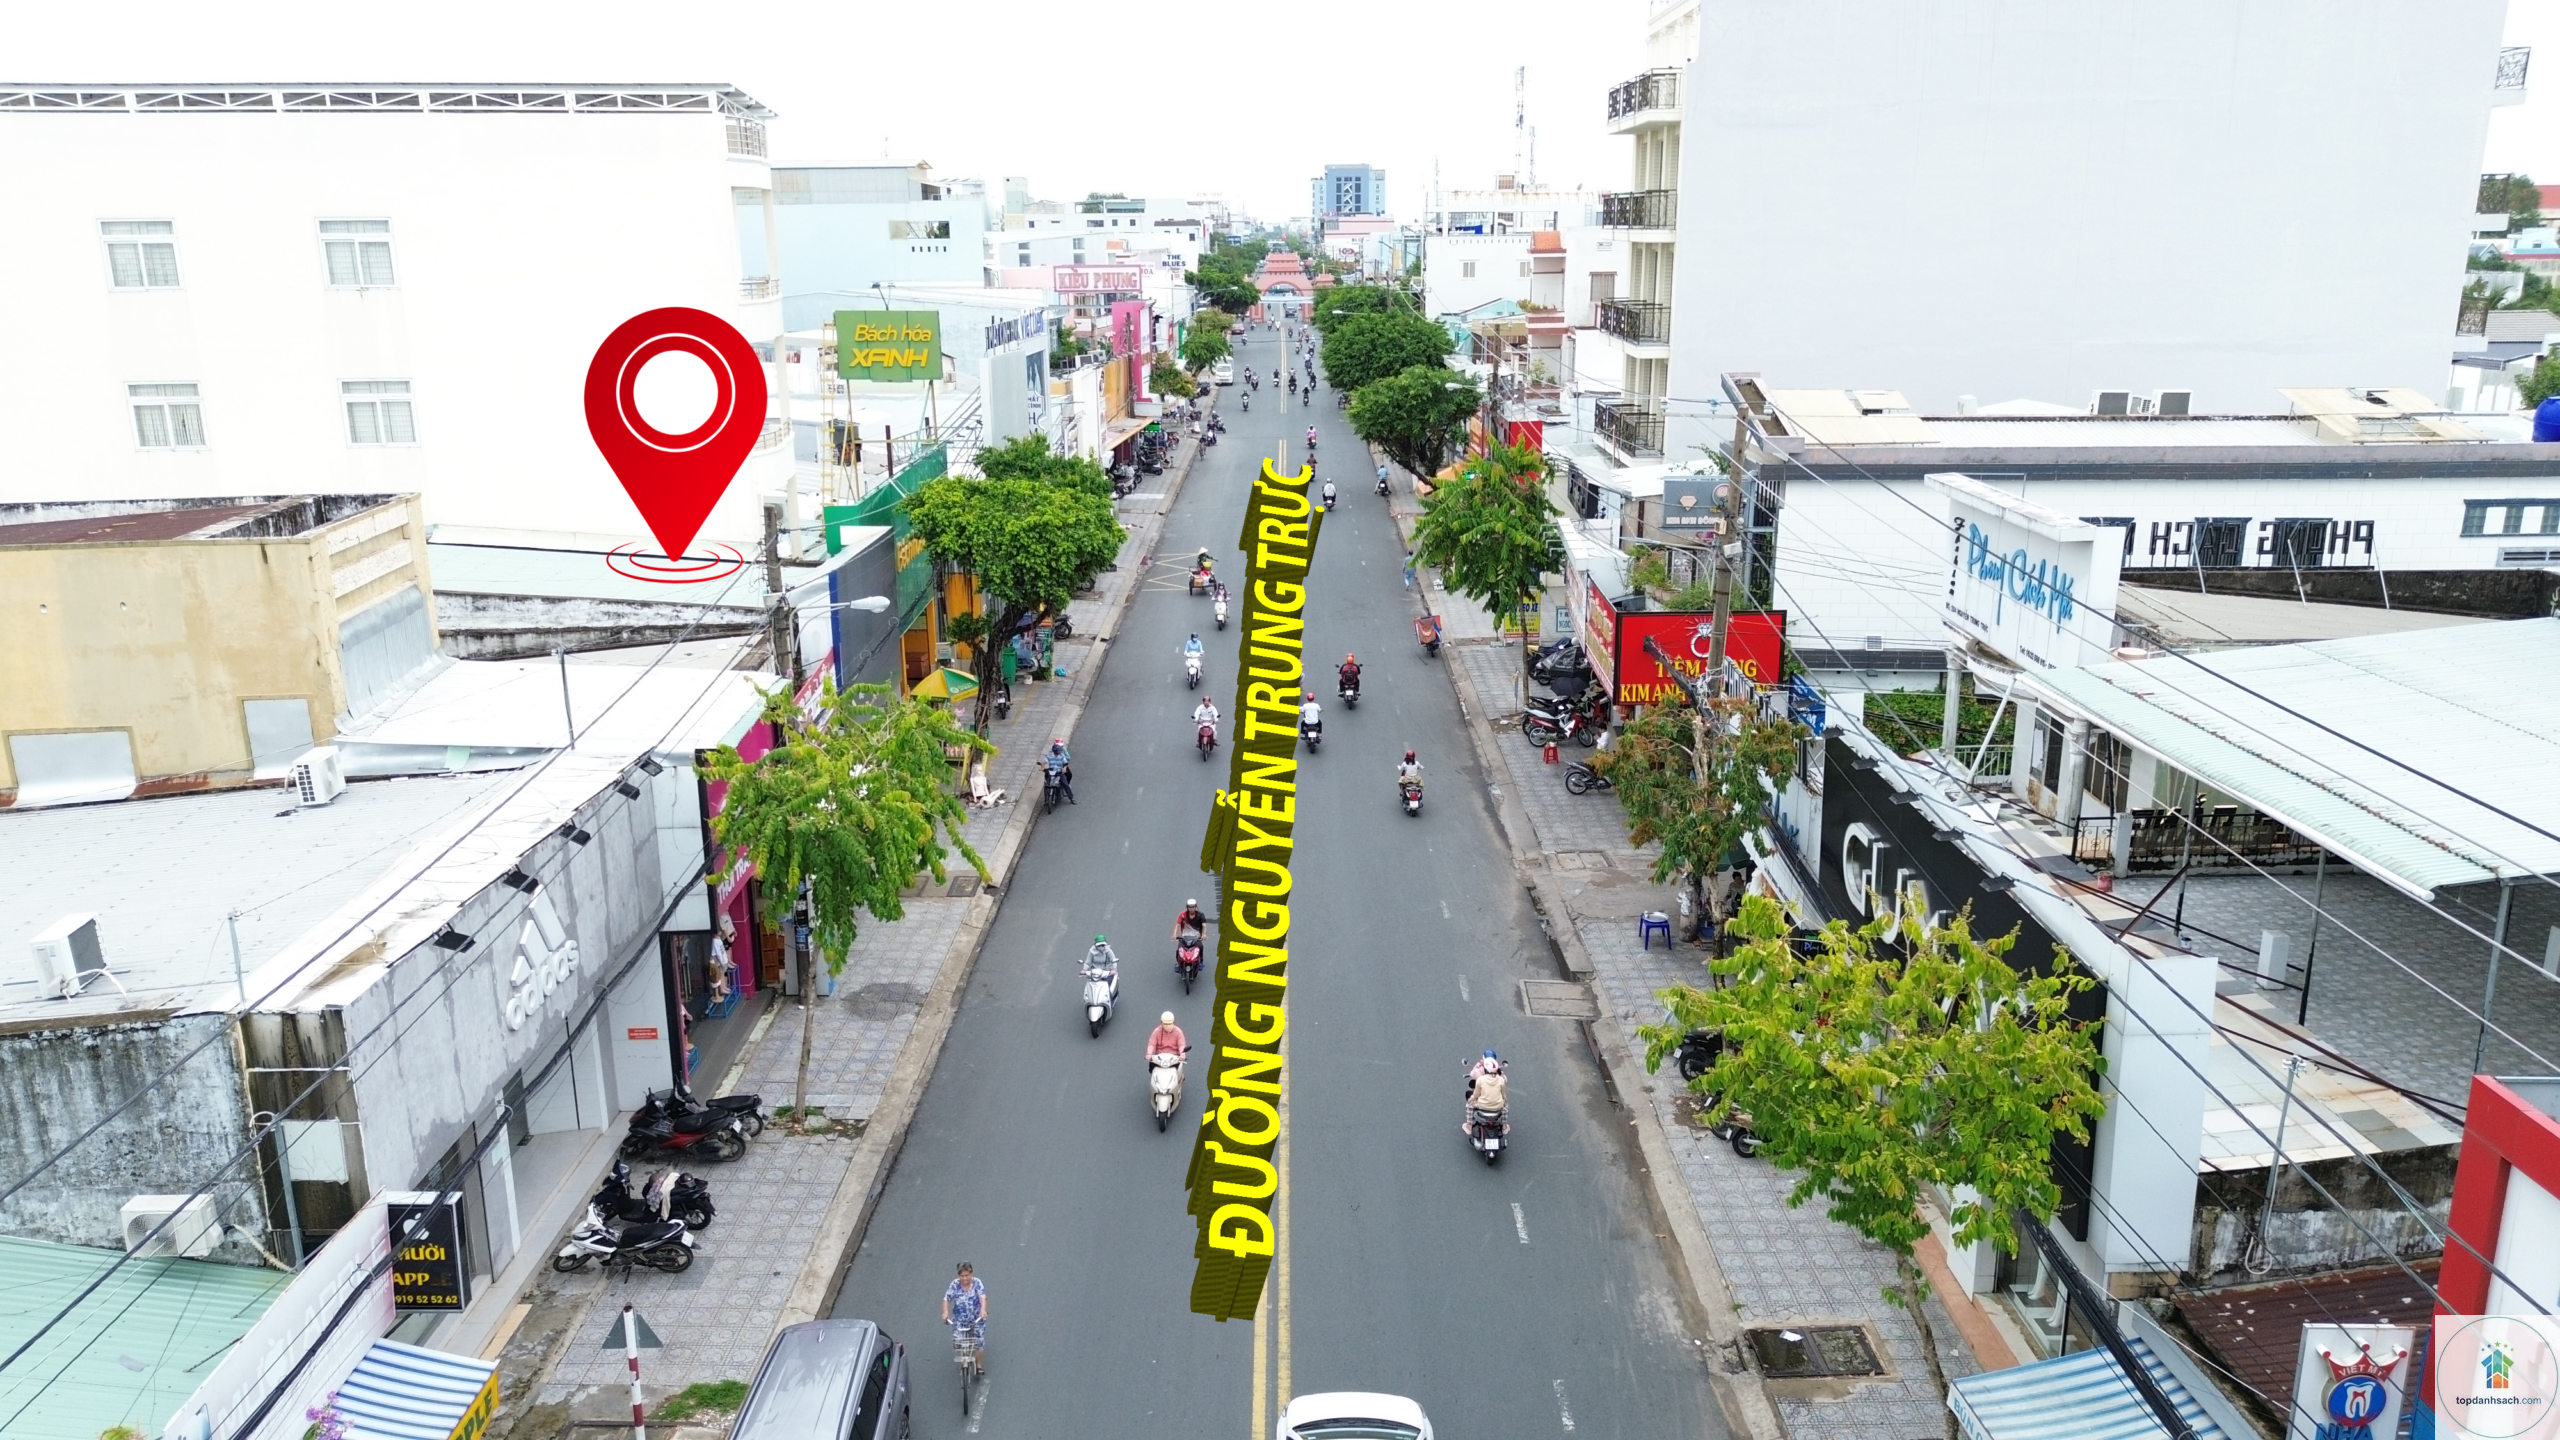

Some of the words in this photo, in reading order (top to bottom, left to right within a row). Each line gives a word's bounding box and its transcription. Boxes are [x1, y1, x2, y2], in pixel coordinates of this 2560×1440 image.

[1058, 267, 1089, 289] KIỀU
[855, 324, 897, 342] Bách
[901, 324, 932, 342] hóa
[849, 348, 929, 367] XANH
[1949, 517, 1965, 596] Fashion
[1620, 684, 1650, 702] KIM
[505, 939, 580, 1031] adidas
[416, 1295, 428, 1304] 52
[430, 1295, 443, 1304] 52
[445, 1295, 458, 1304] 62
